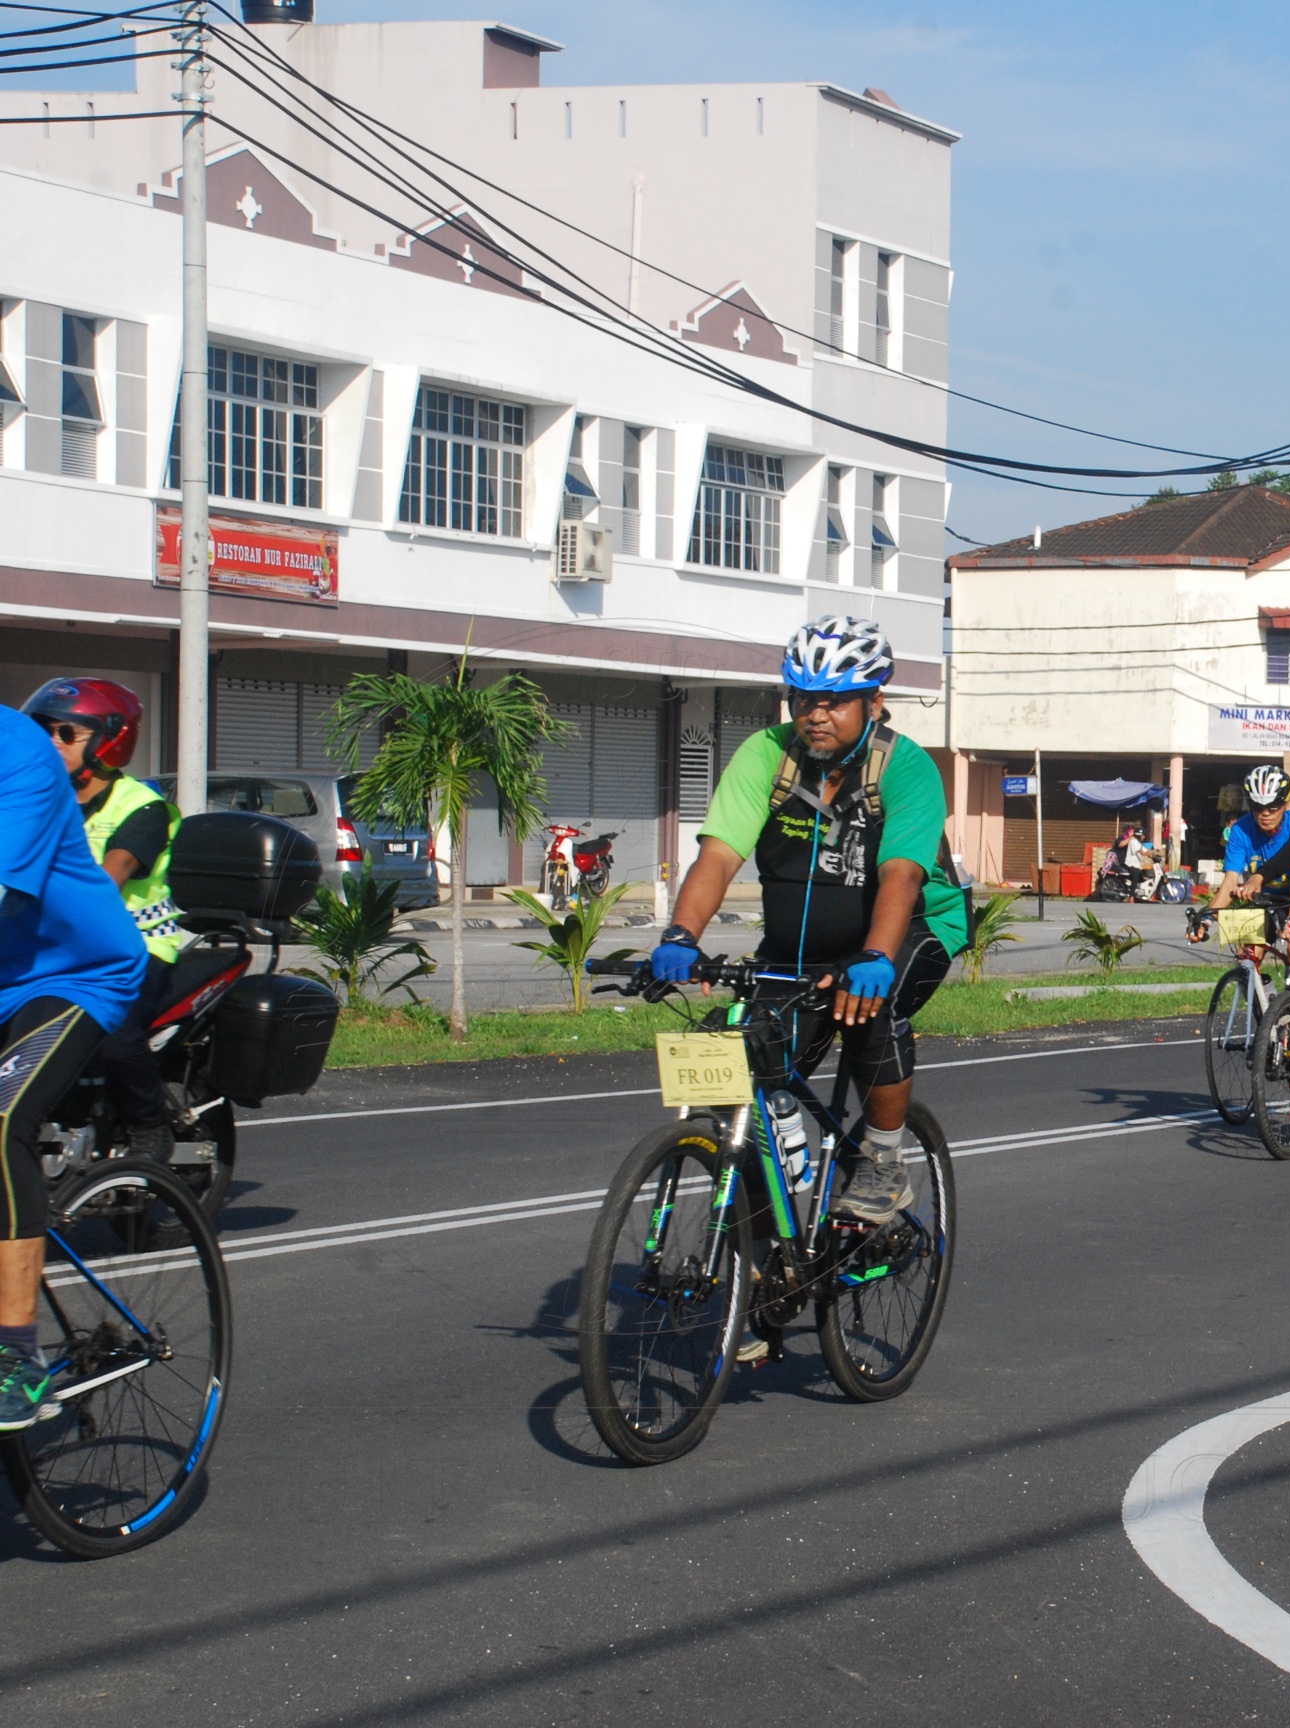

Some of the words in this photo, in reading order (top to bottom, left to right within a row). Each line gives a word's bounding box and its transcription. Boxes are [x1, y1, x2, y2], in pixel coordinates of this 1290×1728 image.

[217, 543, 261, 563] RESTORAN
[264, 548, 281, 566] NUR
[1220, 708, 1247, 720] MINI
[1242, 722, 1265, 730] IKAN
[1268, 723, 1287, 731] DAN
[1228, 925, 1240, 934] FR
[677, 1068, 700, 1085] FR
[703, 1067, 733, 1084] 019
